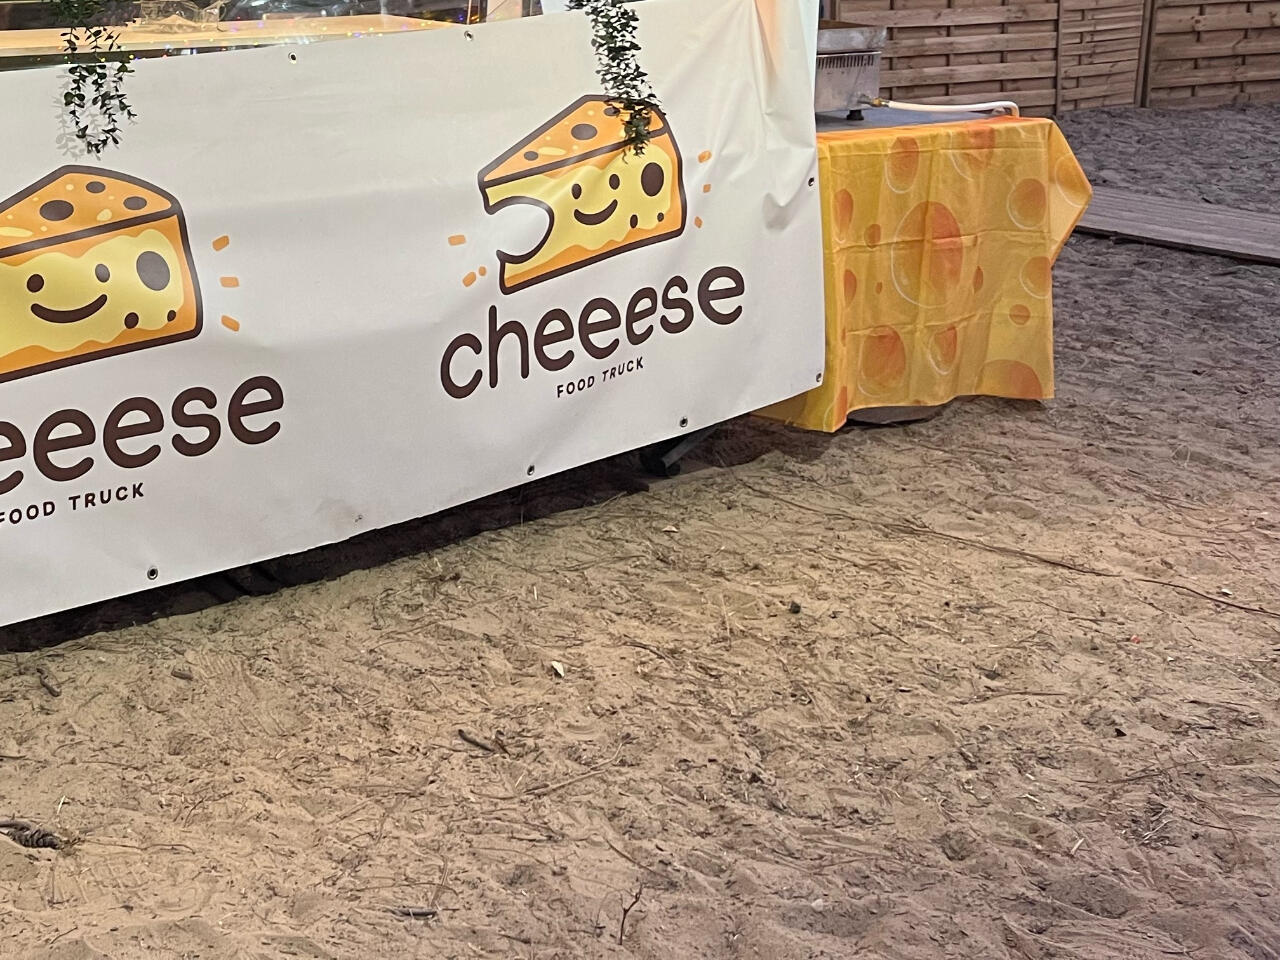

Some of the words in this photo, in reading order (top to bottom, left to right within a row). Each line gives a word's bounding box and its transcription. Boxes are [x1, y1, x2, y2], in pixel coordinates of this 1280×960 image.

[439, 266, 746, 400] cheeese
[556, 374, 595, 399] FOOD
[602, 356, 645, 383] TRUCK
[68, 482, 145, 512] TRUCK
